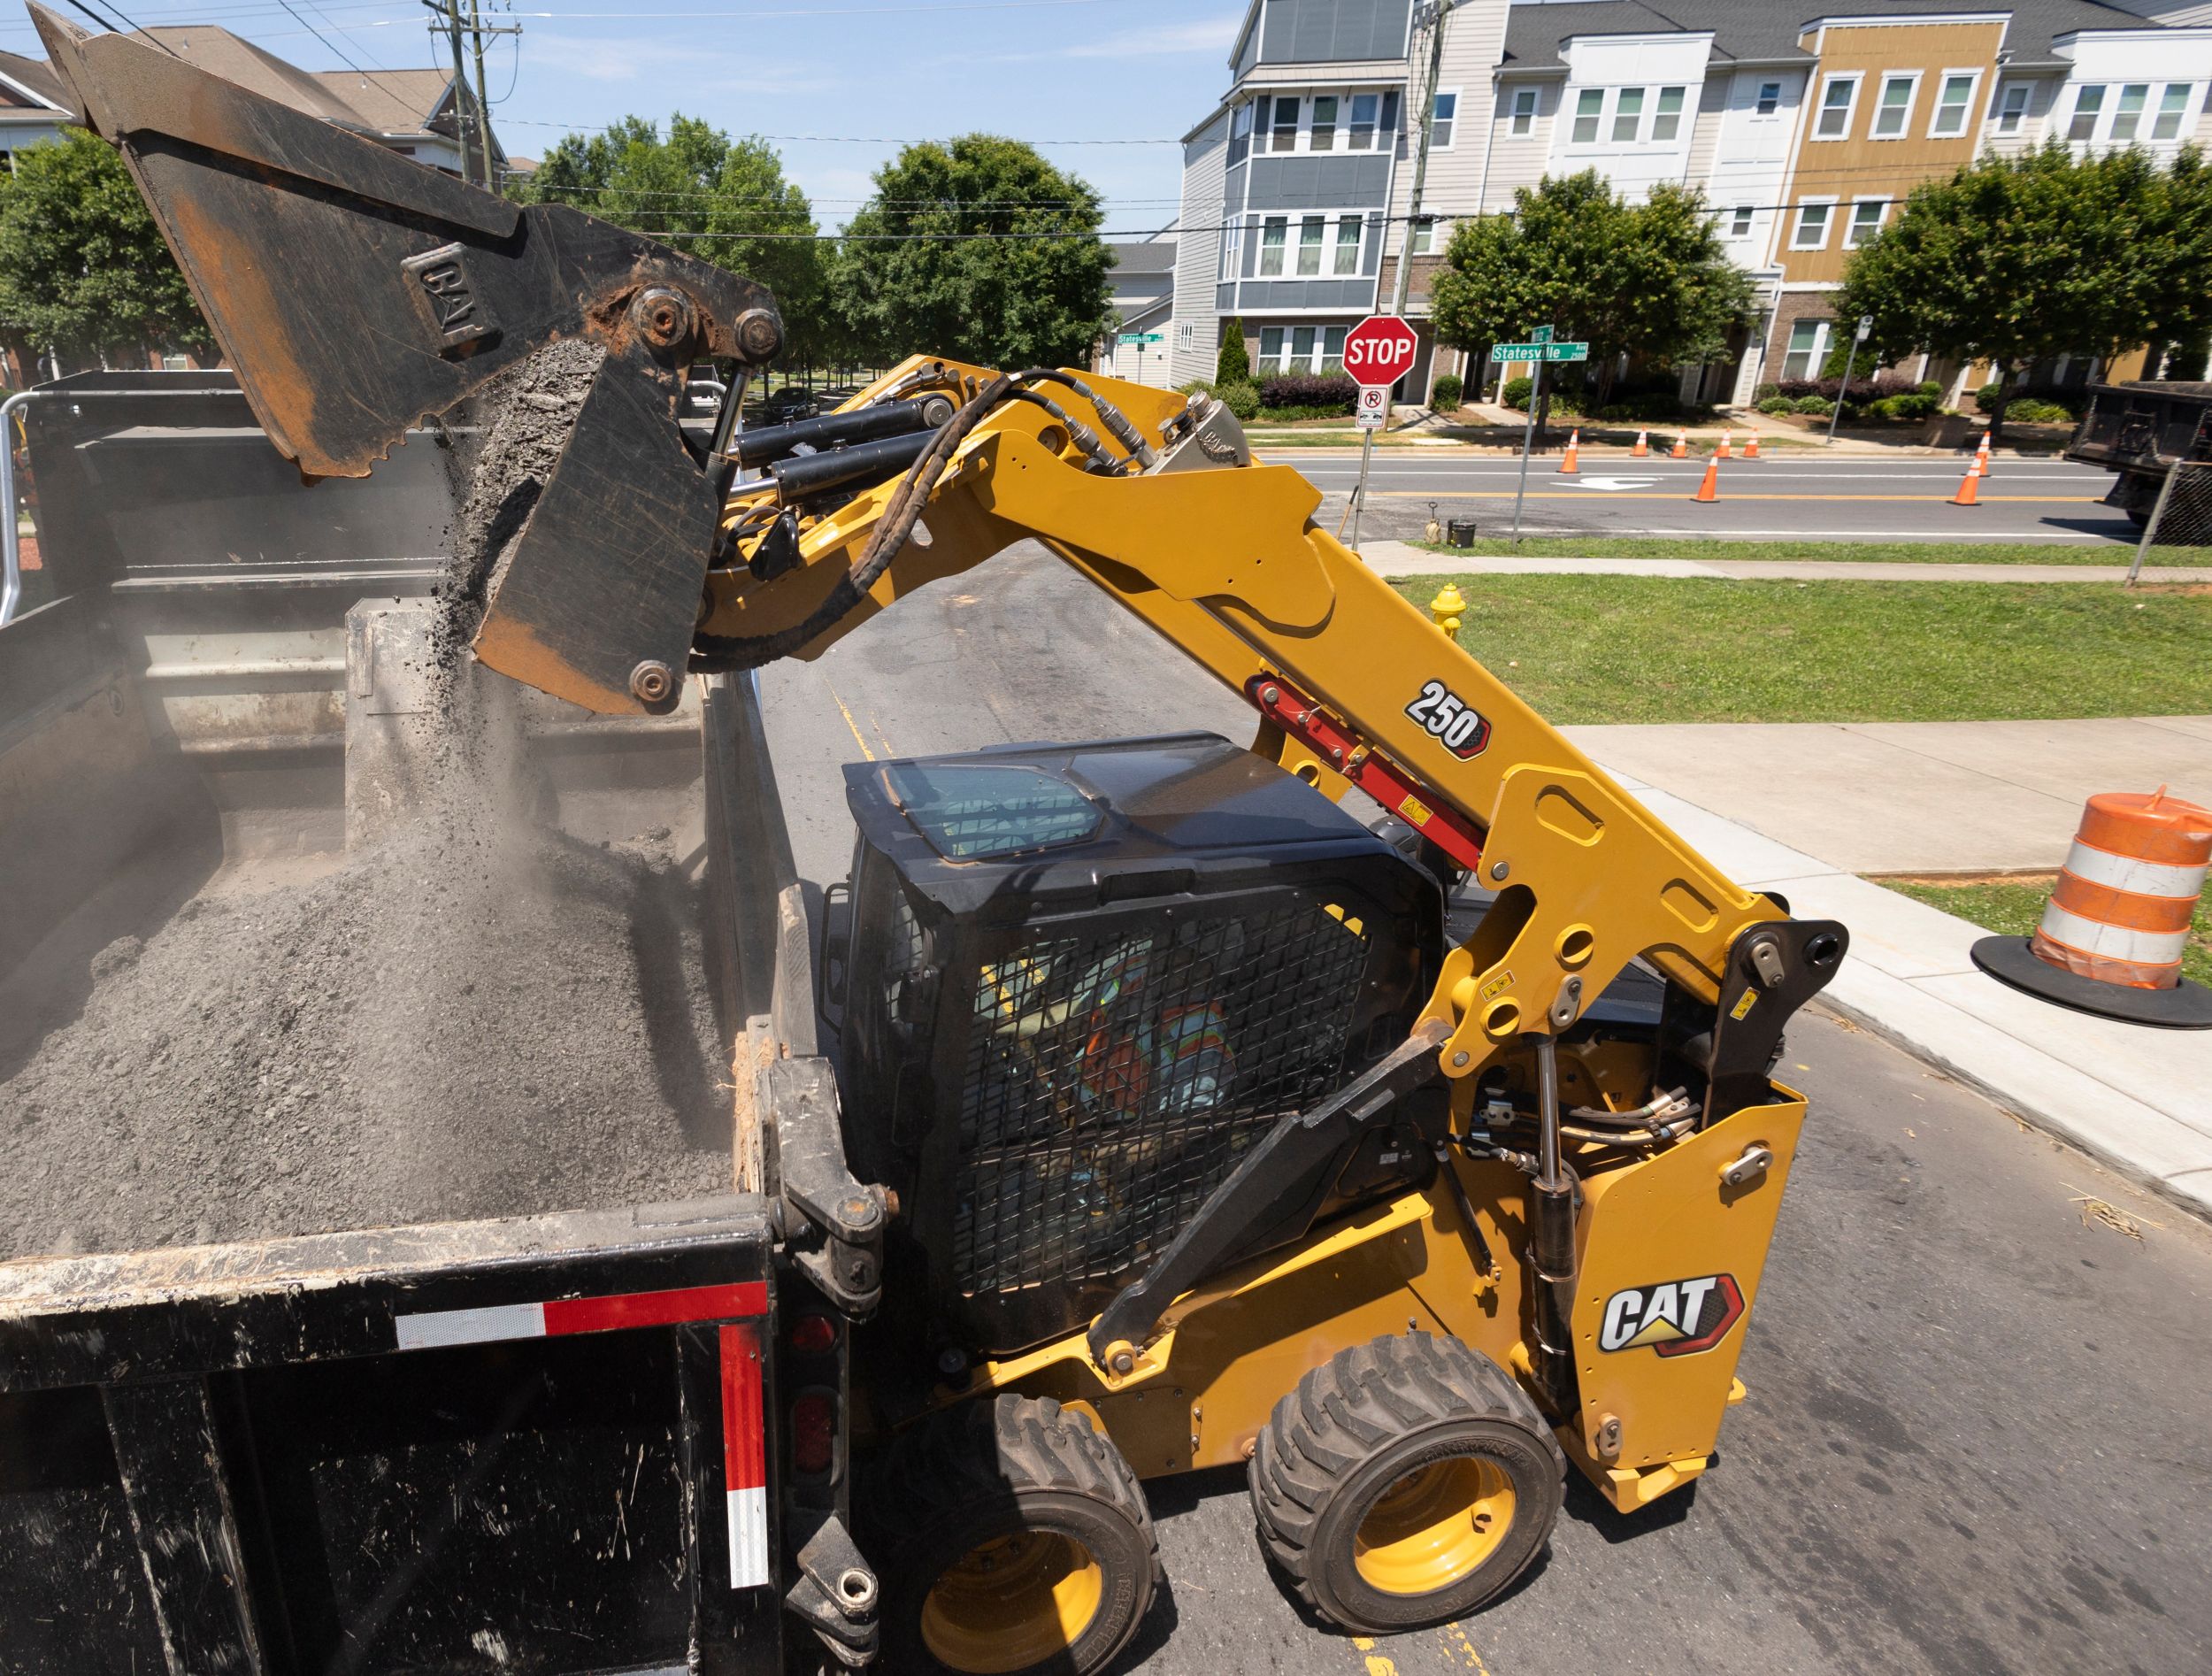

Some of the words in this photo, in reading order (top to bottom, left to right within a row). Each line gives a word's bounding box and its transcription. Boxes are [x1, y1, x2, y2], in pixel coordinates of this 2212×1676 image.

[420, 262, 483, 335] CAT
[1348, 338, 1411, 365] STOP
[1494, 346, 1560, 360] Statesville
[1408, 682, 1479, 748] 250
[1601, 1277, 1717, 1350] CAT
